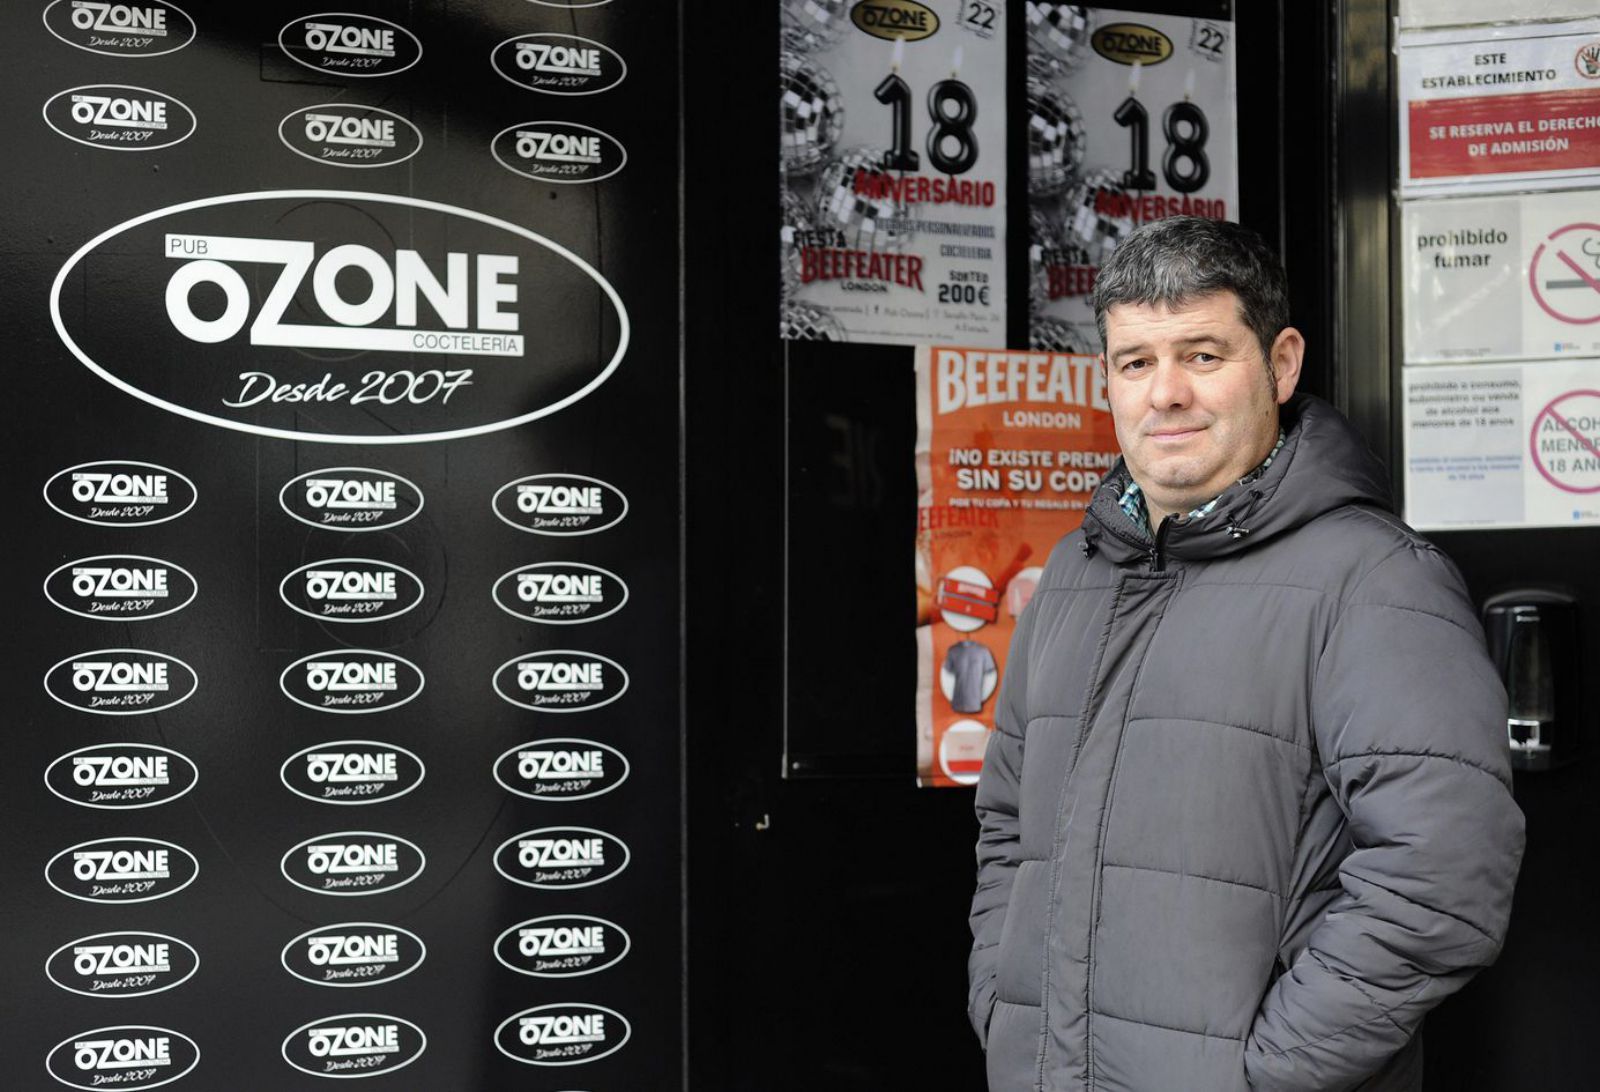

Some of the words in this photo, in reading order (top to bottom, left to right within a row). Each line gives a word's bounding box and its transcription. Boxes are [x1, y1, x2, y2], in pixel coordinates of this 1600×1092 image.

[72, 1, 167, 36] OZONE
[863, 4, 927, 31] OZONE
[967, 2, 996, 30] 22
[305, 23, 395, 57] OZONE
[1102, 31, 1161, 56] OZONE
[1198, 28, 1224, 54] 22
[516, 43, 601, 75] OZONE
[1475, 53, 1507, 65] ESTE
[1422, 69, 1556, 89] ESTABLECIMIENTO
[72, 95, 167, 129] OZONE
[874, 73, 979, 174] 18
[306, 114, 395, 147] OZONE
[1429, 127, 1446, 139] SE
[1451, 122, 1514, 138] RESERVA
[1518, 121, 1534, 133] EL
[516, 131, 601, 163] OZONE
[1113, 97, 1211, 194] 18
[1468, 144, 1487, 156] DE
[1491, 136, 1569, 155] ADMISIÓN
[170, 238, 208, 254] PUB
[1418, 228, 1508, 250] prohibido
[801, 247, 924, 294] BEEFEATER
[1434, 252, 1491, 268] fumar
[840, 281, 888, 293] LONDON
[949, 271, 989, 284] SORTEO
[165, 234, 524, 356] OZONE
[938, 284, 991, 306] 200€
[412, 333, 518, 352] COCTELERÍA
[222, 370, 350, 408] Desde
[350, 368, 474, 405] 2007
[938, 350, 1110, 415] BEEFEATE
[1003, 411, 1081, 429] LONDON
[988, 449, 1053, 467] EXISTE
[1058, 451, 1121, 469] PREMI
[1549, 458, 1567, 473] 18
[72, 473, 168, 503] OZONE
[306, 479, 396, 509] OZONE
[957, 468, 1000, 490] SIN
[1008, 470, 1043, 491] SU
[1049, 471, 1103, 493] COP
[517, 485, 602, 514] OZONE
[73, 568, 168, 597] OZONE
[307, 571, 397, 599] OZONE
[518, 574, 603, 602] OZONE
[73, 662, 169, 691] OZONE
[307, 662, 397, 690] OZONE
[518, 663, 603, 690] OZONE
[73, 757, 169, 786] OZONE
[307, 753, 397, 782] OZONE
[518, 751, 604, 779] OZONE
[74, 850, 169, 880] OZONE
[308, 844, 398, 873] OZONE
[519, 839, 604, 867] OZONE
[308, 935, 398, 965] OZONE
[519, 927, 604, 956] OZONE
[74, 944, 170, 975] OZONE
[308, 1025, 399, 1057] OZONE
[519, 1014, 605, 1045] OZONE
[75, 1038, 171, 1070] OZONE
